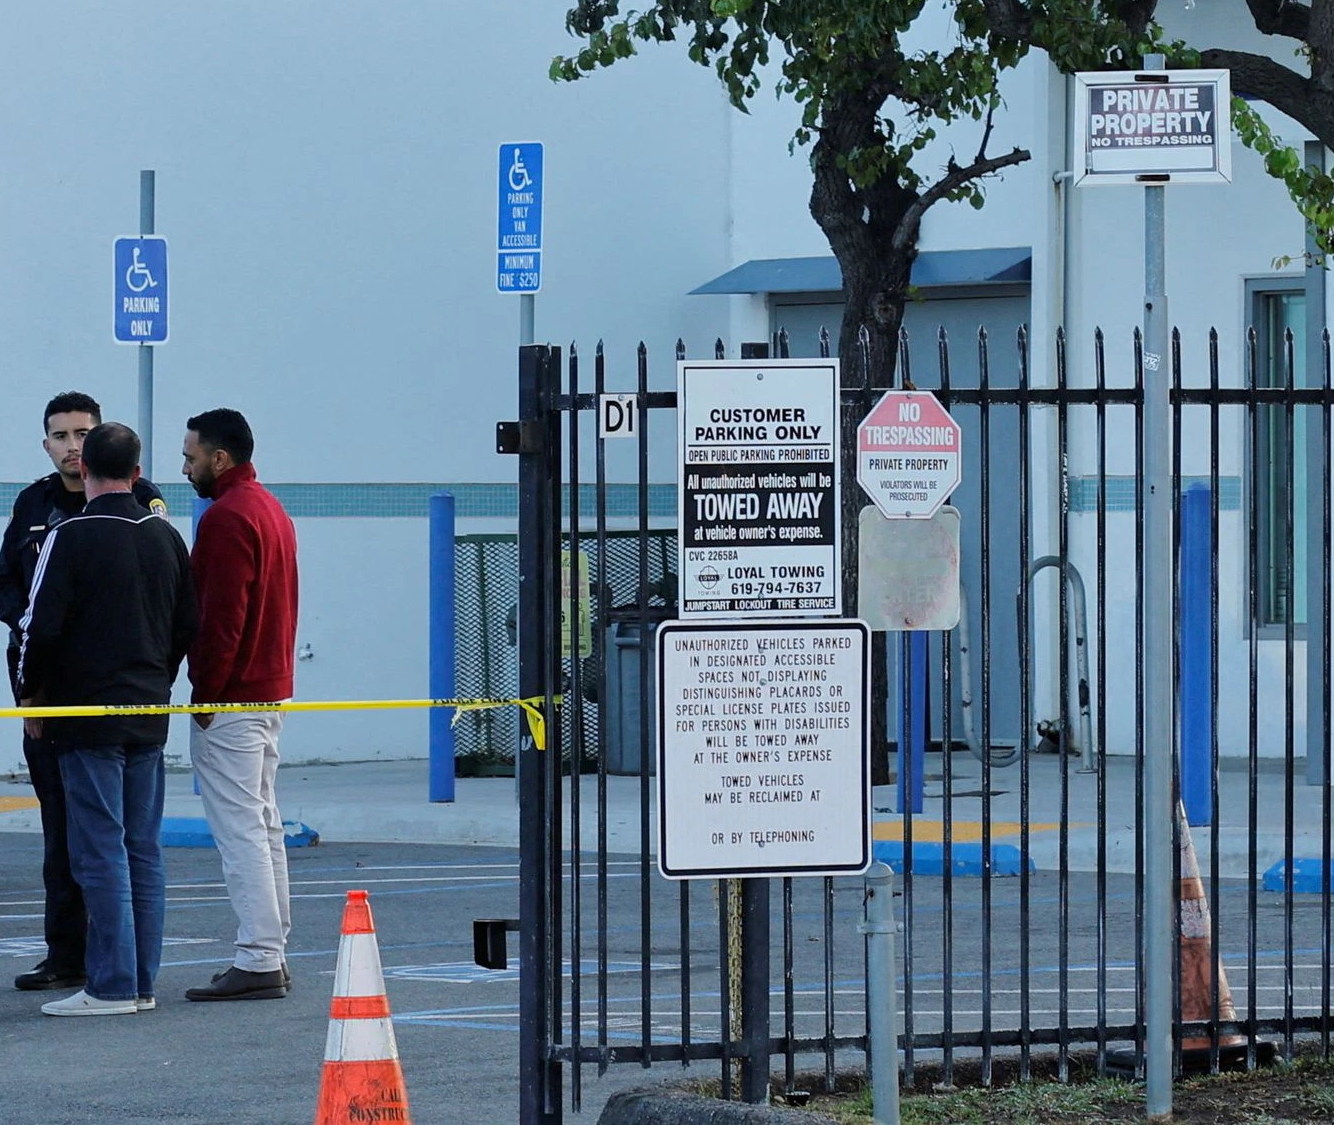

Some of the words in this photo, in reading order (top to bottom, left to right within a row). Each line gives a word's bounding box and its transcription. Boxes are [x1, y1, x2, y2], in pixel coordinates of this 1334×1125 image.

[1103, 88, 1199, 112] PRIVATE
[1091, 111, 1211, 135] PROPERTY
[1091, 137, 1111, 147] NO
[1115, 134, 1213, 146] TRESPASSING
[507, 192, 534, 204] PARKING
[512, 206, 529, 219] ONLY
[514, 220, 526, 232] VAN
[502, 234, 537, 247] ACCESSIBLE
[504, 255, 534, 270] MINIMUM
[499, 273, 515, 287] FINE
[519, 271, 538, 288] $250
[123, 297, 160, 313] PARKING
[130, 320, 153, 336] ONLY
[606, 400, 633, 432] D1
[710, 408, 805, 423] CUSTOMER
[898, 403, 921, 422] NO
[695, 426, 767, 441] PARKING
[775, 425, 822, 440] ONLY
[865, 426, 954, 446] TRESPASSING
[689, 450, 708, 462] OPEN
[711, 449, 738, 461] PUBLIC
[740, 449, 775, 461] PARKING
[778, 448, 830, 460] PROHIBITED
[869, 459, 902, 470] PRIVATE
[905, 459, 948, 471] PROPERTY
[687, 474, 699, 490] All
[701, 473, 755, 489] unauthorized
[758, 473, 796, 489] vehicles
[799, 472, 816, 488] will
[819, 472, 831, 488] be
[880, 480, 912, 489] VIOLATORS
[913, 480, 928, 489] WILL
[929, 480, 937, 489] BE
[889, 492, 928, 501] PROSECUTED
[693, 493, 760, 521] TOWED
[766, 492, 824, 520] AWAY
[694, 526, 703, 541] at
[705, 525, 737, 540] vehicle
[738, 525, 776, 539] owner's
[778, 526, 823, 542] expense.
[689, 551, 705, 561] CVC
[708, 550, 739, 561] 22658A
[727, 566, 765, 579] LOYAL
[770, 565, 825, 579] TOWING
[731, 581, 822, 595] 619-794-7637
[685, 600, 730, 611] JUMPSTART
[735, 599, 772, 610] LOCKOUT
[777, 599, 796, 609] TIRE
[798, 598, 834, 609] SERVICE
[675, 639, 749, 651] UNAUTHORIZED
[756, 638, 805, 650] VEHICLES
[813, 637, 851, 649] PARKED
[689, 656, 699, 667] IN
[707, 654, 767, 667] DESIGNATED
[774, 654, 836, 666] ACCESSIBLE
[698, 672, 734, 683] SPACES
[741, 671, 761, 683] NOT
[767, 670, 827, 682] DISPLAYING
[682, 687, 762, 700] DISTINGUISHING
[770, 686, 822, 698] PLACARDS
[829, 686, 843, 697] OR
[676, 704, 715, 716] SPECIAL
[723, 703, 764, 715] LICENSE
[771, 702, 807, 714] PLATES
[814, 701, 850, 713] ISSUED
[676, 720, 695, 732] FOR
[702, 719, 747, 731] PERSONS
[754, 719, 777, 730] WITH
[785, 717, 850, 730] DISABILITIES
[706, 736, 728, 748] WILL
[735, 736, 748, 747] BE
[755, 734, 787, 746] TOWED
[795, 734, 820, 746] AWAY
[693, 752, 704, 764] AT
[711, 752, 728, 764] THE
[736, 751, 781, 763] OWNER'S
[788, 750, 832, 762] EXPENSE
[721, 776, 751, 788] TOWED
[759, 774, 804, 786] VEHICLES
[705, 793, 723, 804] MAY
[730, 792, 742, 803] BE
[749, 790, 803, 803] RECLAIMED
[810, 790, 821, 801] AT
[712, 833, 724, 844] OR
[731, 832, 743, 844] BY
[750, 830, 815, 843] TELEPHONING
